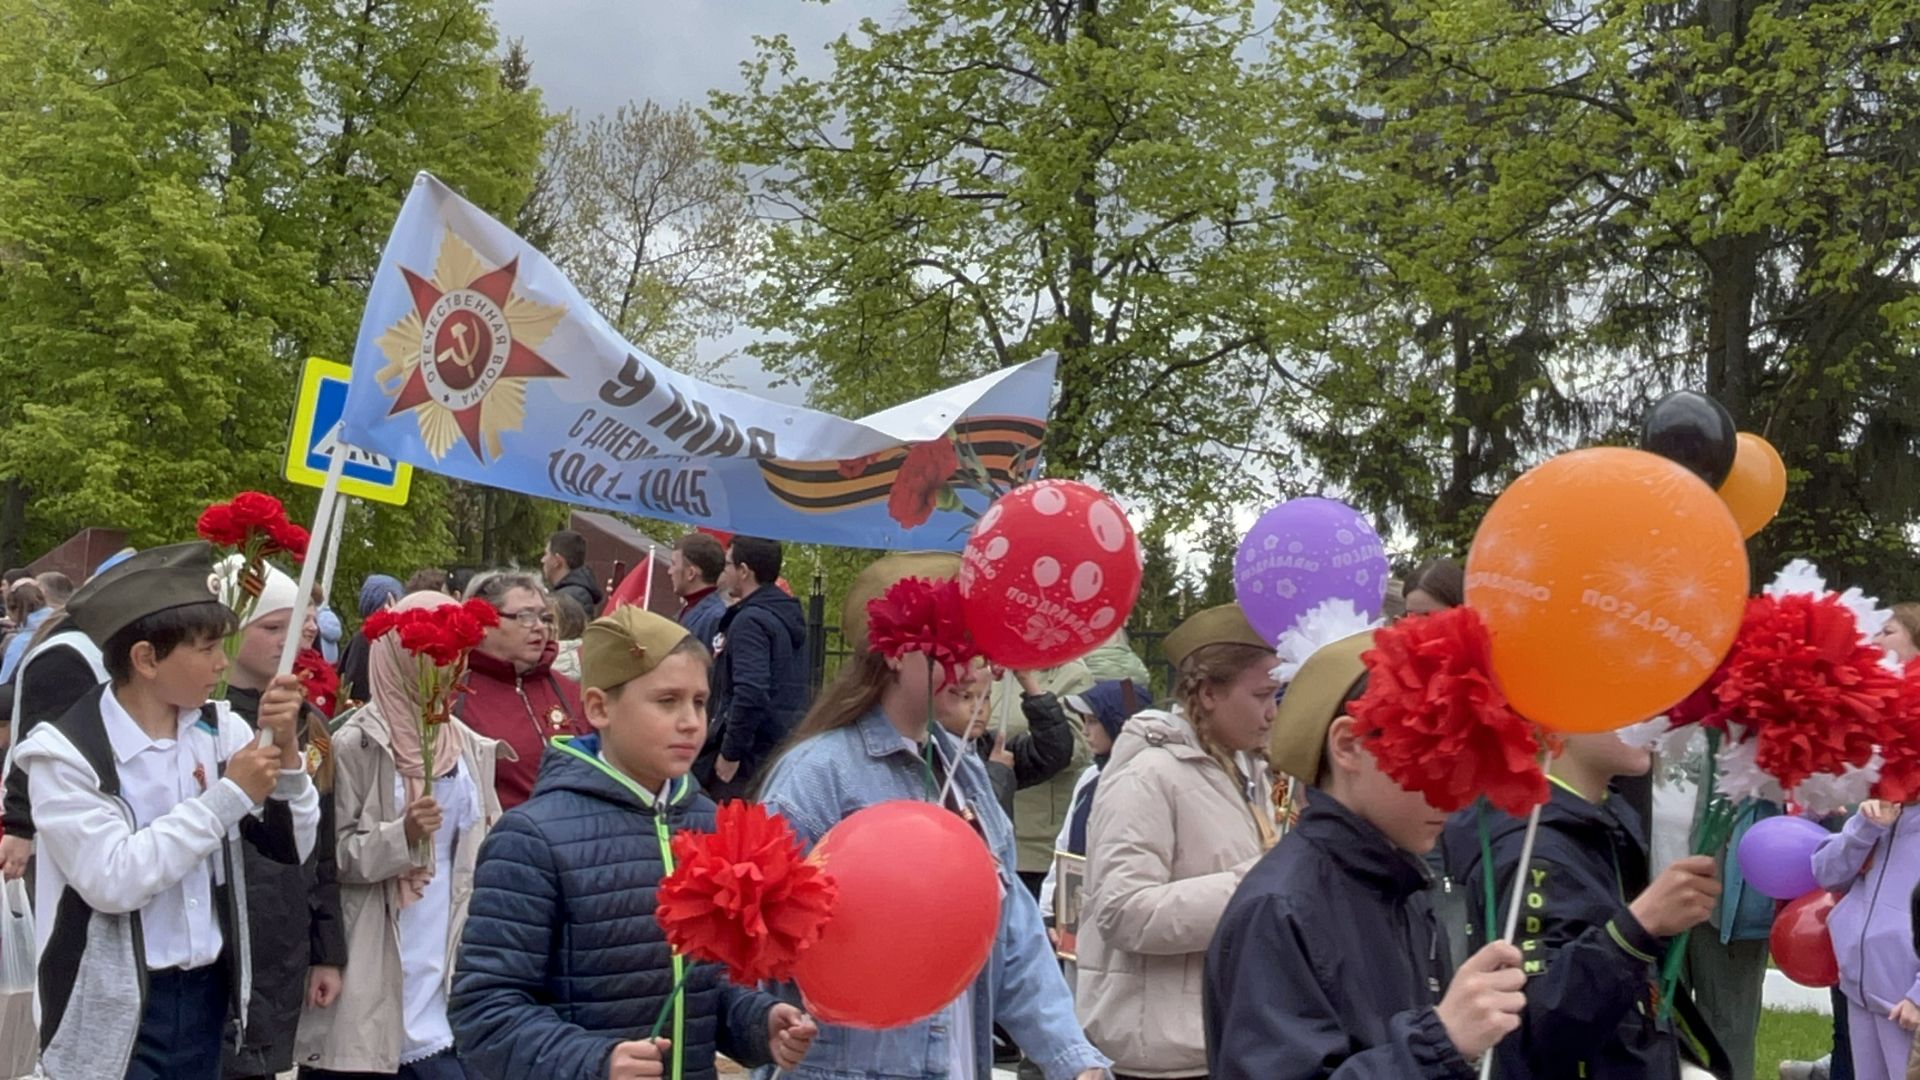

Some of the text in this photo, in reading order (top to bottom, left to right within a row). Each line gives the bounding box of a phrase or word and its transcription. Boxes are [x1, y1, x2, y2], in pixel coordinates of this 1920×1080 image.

[422, 294, 508, 405] ОТЕЧЕСТВЕННАЯ ВОЙНА
[598, 353, 657, 407] 9
[568, 408, 597, 438] С
